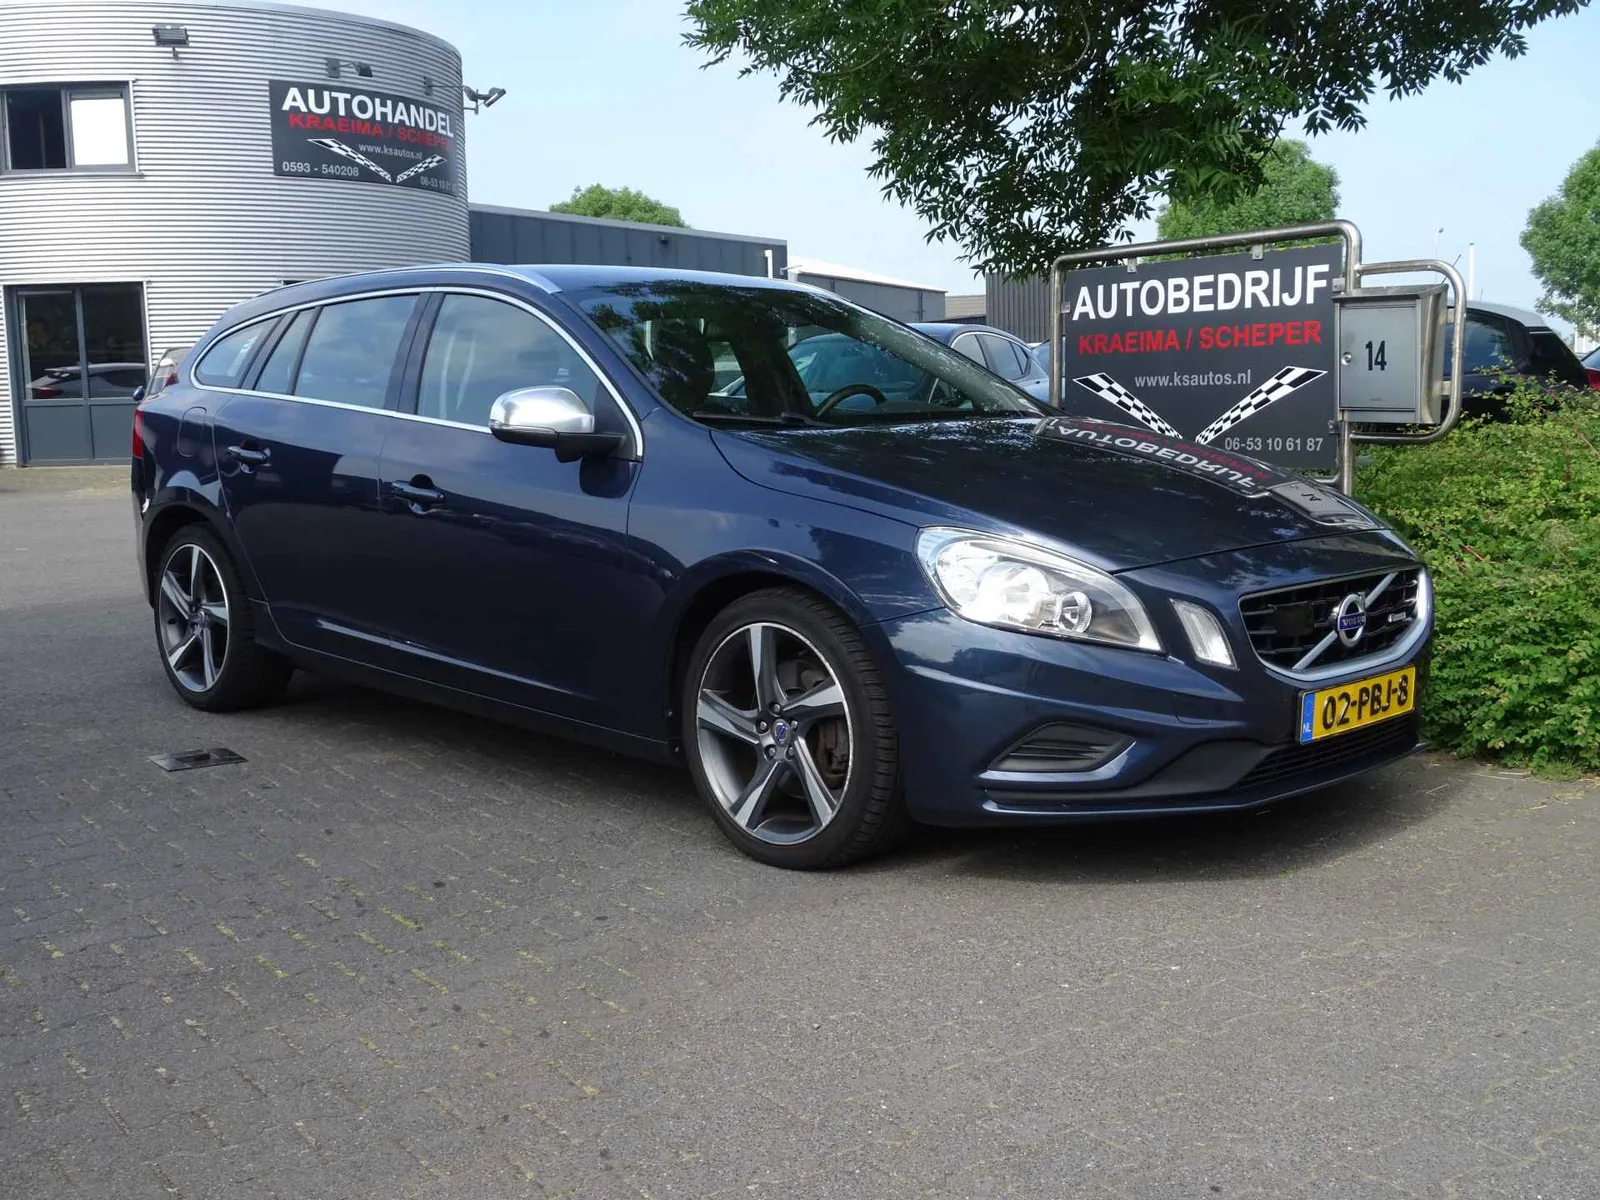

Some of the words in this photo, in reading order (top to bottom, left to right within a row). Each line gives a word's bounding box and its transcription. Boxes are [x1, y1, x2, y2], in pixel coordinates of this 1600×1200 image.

[282, 87, 454, 137] AUTOHANDEL
[289, 113, 384, 137] KRAEIMA
[358, 143, 423, 161] www.ksautos.nl
[282, 161, 311, 174] 0593
[322, 164, 359, 177] 540208
[1072, 264, 1330, 321] AUTOBEDRIJF
[1078, 327, 1180, 355] KRAEIMA
[1199, 320, 1322, 350] SCHEPER
[1364, 340, 1387, 371] 14
[1135, 368, 1251, 388] www.ksautos.nl
[1224, 437, 1262, 452] 06-53
[1266, 437, 1282, 451] 10
[1286, 437, 1301, 451] 61
[1306, 436, 1323, 451] 87
[1322, 674, 1409, 730] 02-PBJ-8
